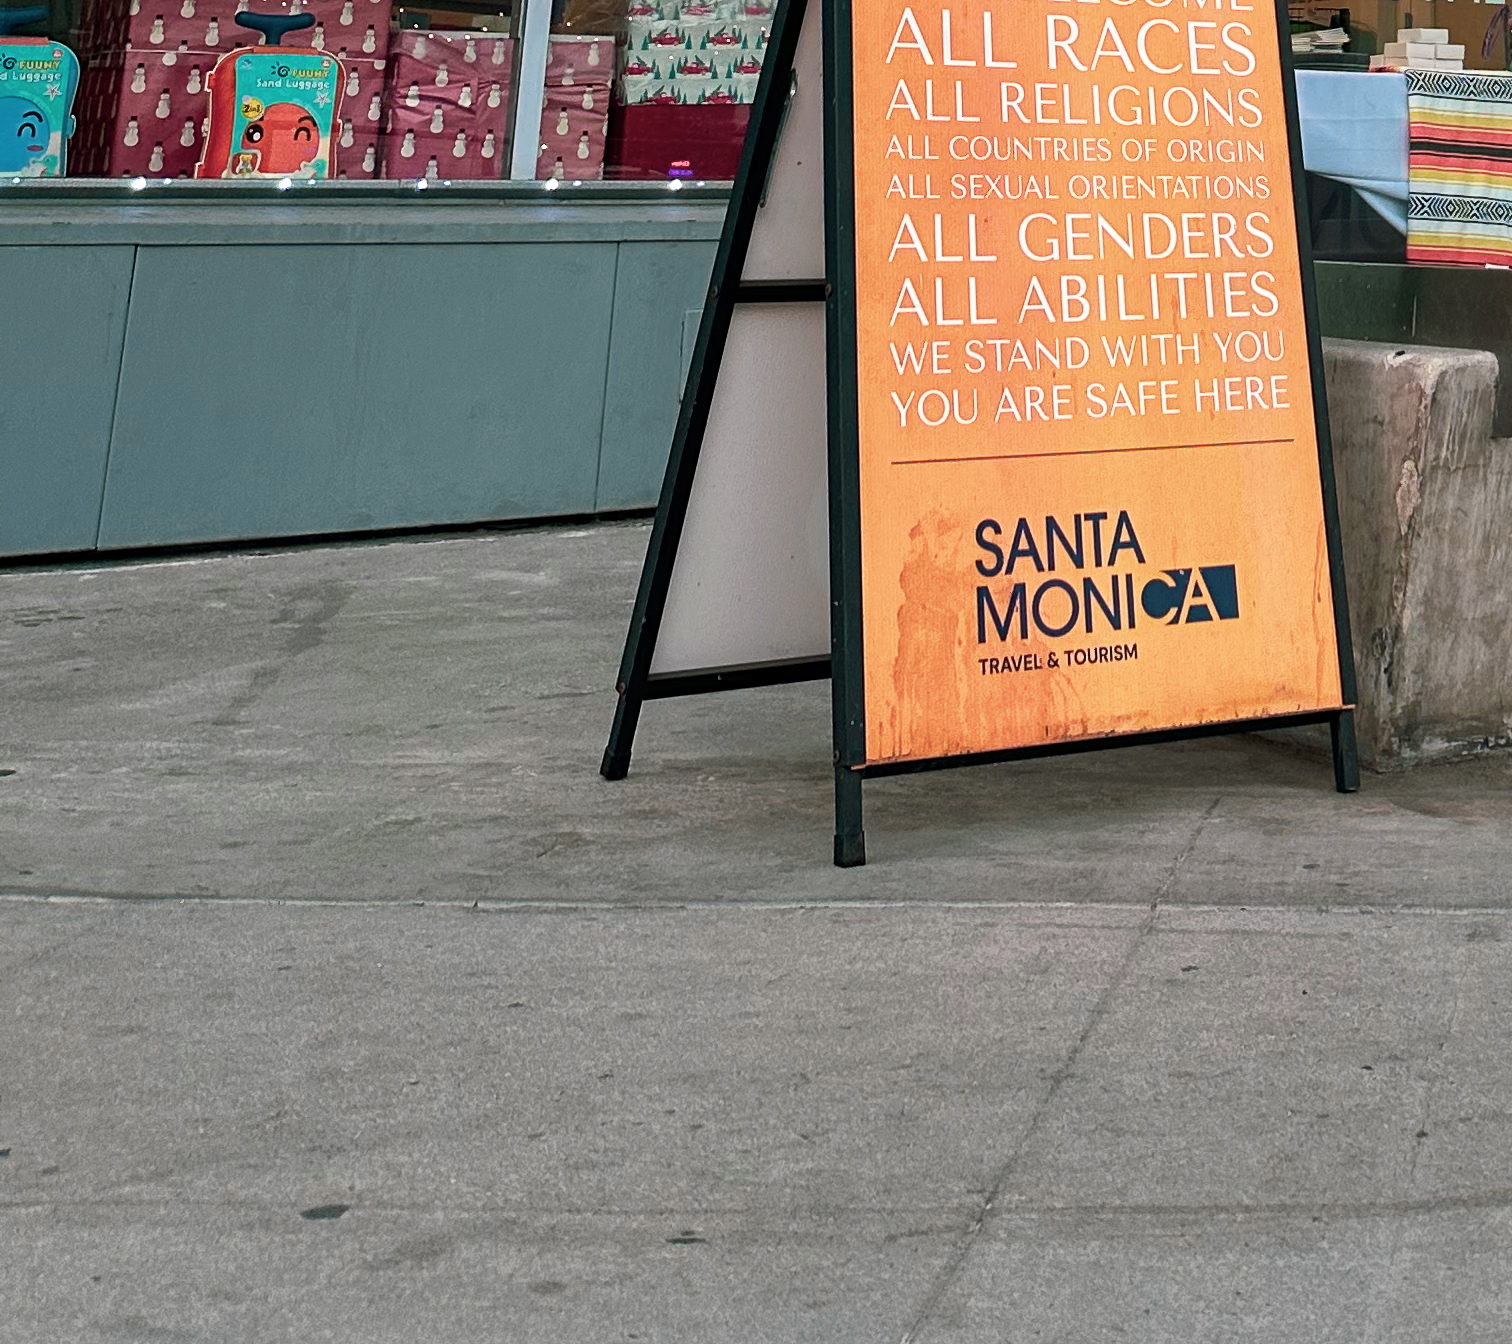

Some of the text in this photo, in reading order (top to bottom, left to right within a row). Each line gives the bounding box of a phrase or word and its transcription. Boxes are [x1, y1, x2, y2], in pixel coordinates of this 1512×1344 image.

[885, 6, 1257, 77] ALL RACES
[12, 71, 62, 83] Luggage
[256, 77, 330, 91] Sand Luggage
[885, 78, 1264, 129] ALL RELIGIONS
[885, 135, 1265, 164] ALL COUNTRIES OF ORIGIN
[885, 173, 1271, 201] ALL SEXUAL ORIENTATIONS
[888, 211, 1275, 264] ALL GENDERS
[888, 271, 1280, 328] ALL ABILITIES
[889, 330, 1286, 376] WE STAND WITH YOU
[890, 375, 1291, 428] YOU ARE SAFE HERE
[974, 509, 1147, 578] SANTA
[975, 564, 1241, 645] MONICA
[978, 643, 1139, 676] TRAVEL & TOURISM
